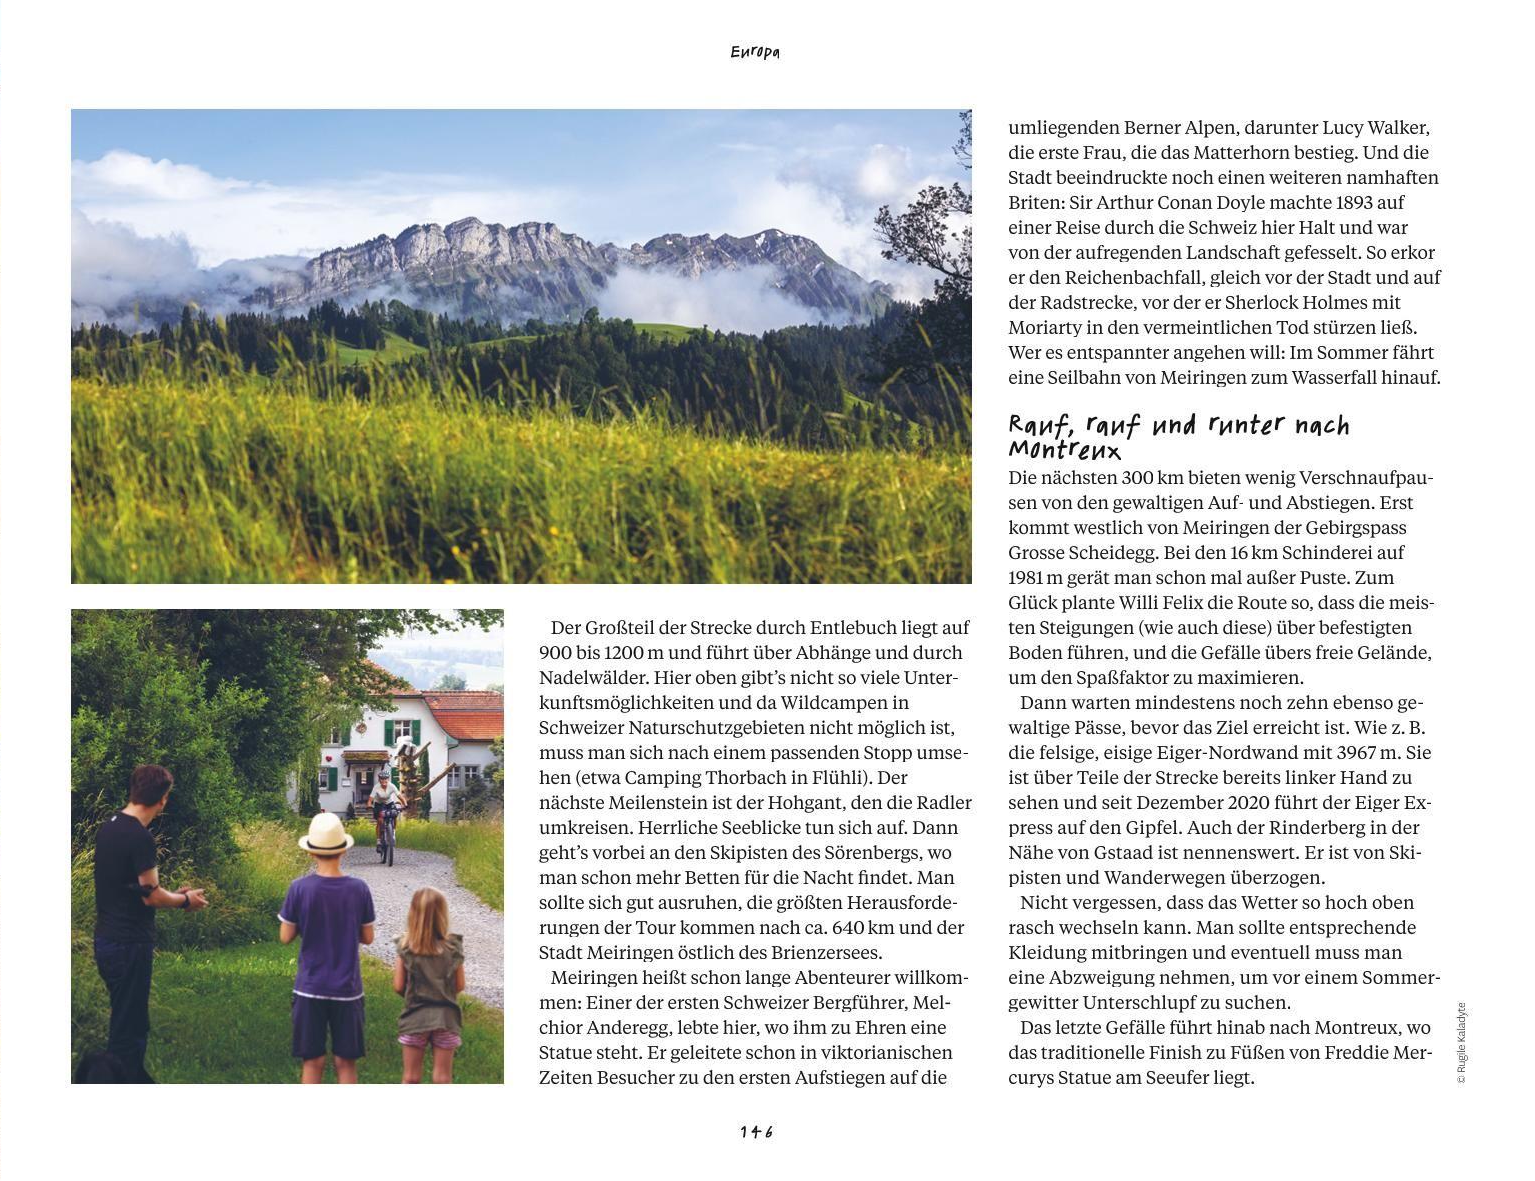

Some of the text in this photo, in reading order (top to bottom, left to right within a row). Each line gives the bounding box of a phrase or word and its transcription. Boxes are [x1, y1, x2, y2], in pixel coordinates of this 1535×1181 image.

[731, 46, 779, 60] Europa
[1008, 144, 1429, 164] die erste Frau, die das Matterhorn bestieg. Und die
[1008, 219, 1409, 235] einer Reise durch die Schweiz hier Halt und war
[1008, 294, 1401, 312] der Radstrecke, vor der er Sherlock Holmes mit
[1008, 369, 1441, 388] eine Seilbahn von Meiringen zum Wasserfall hinauf.
[1008, 412, 1350, 441] Rauf, rauf und runter nach
[1008, 438, 1122, 461] Montreux
[1008, 469, 1434, 489] Die nächsten 300 km bieten wenig Verschnaufpau-
[550, 619, 971, 639] Der Großteil der Strecke durch Entlebuch liegt auf
[1008, 619, 1413, 639] ten Steigungen (wie auch diese) über befestigten
[539, 694, 910, 714] kunftsmöglichkeiten und da Wildcampen in
[1020, 694, 1424, 714] Dann warten mindestens noch zehn ebenso ge-
[539, 769, 909, 789] hen (etwa Camping Thorbach in Flühli). Der
[538, 844, 952, 864] geht’s vorbei an den Skipisten des Sörenbergs, wo
[1008, 844, 1422, 860] Nähe von Gstaad ist nennenswert. Er ist von Ski-
[539, 919, 965, 938] rungen der Tour kommen nach ca. 640 km und der
[1008, 919, 1417, 939] rasch wechseln kann. Man sollte entsprechende
[539, 994, 951, 1013] men: Einer der ersten Schweizer Bergführer, Mel-
[1008, 994, 1291, 1014] gewitter Unterschlupf zu suchen.
[1457, 1002, 1469, 1083] © Rugile Kaladyte
[539, 1069, 947, 1089] Zeiten Besucher zu den ersten Aufstiegen auf die
[1008, 1069, 1255, 1089] curys Statue am Seeufer liegt.
[741, 1126, 772, 1139] 146
